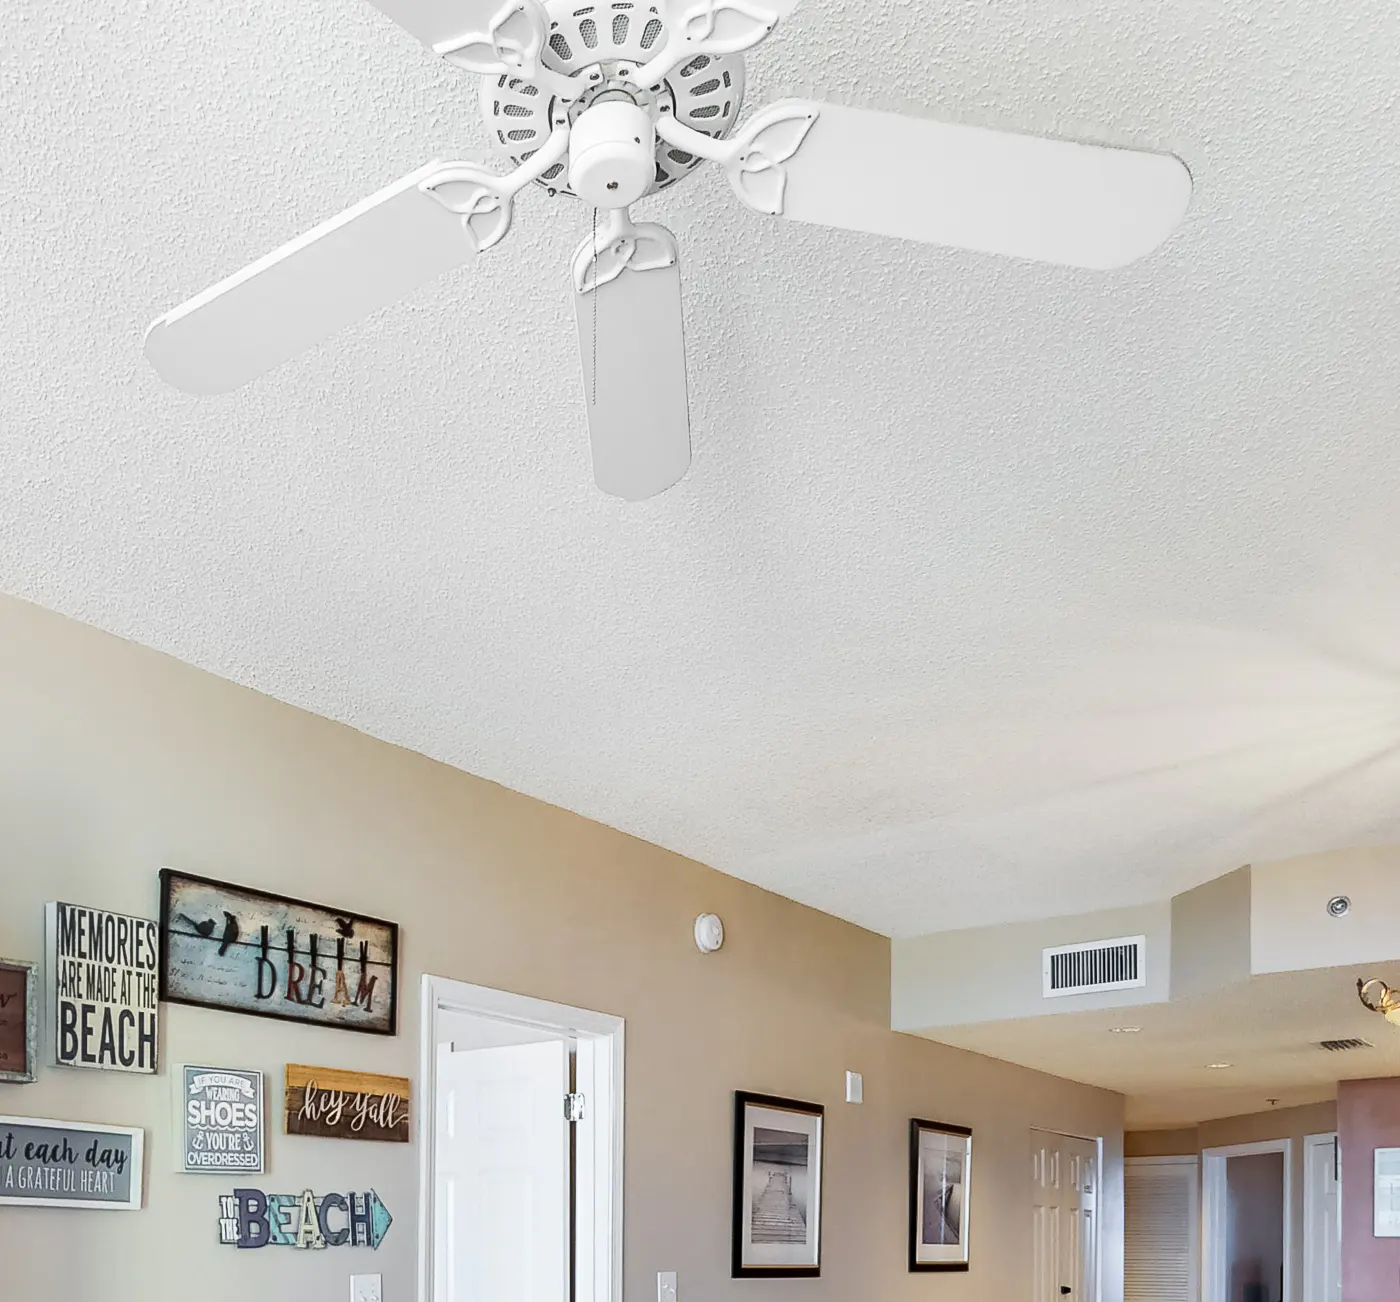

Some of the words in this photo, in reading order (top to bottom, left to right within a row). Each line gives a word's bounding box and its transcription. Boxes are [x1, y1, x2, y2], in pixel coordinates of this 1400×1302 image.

[60, 905, 156, 971] MEMORIES
[60, 959, 83, 999] ARE
[86, 963, 117, 1004] MADE
[120, 969, 133, 1006] AT
[136, 971, 156, 1009] THE
[254, 956, 378, 1013] DREAM
[60, 1000, 156, 1070] BEACH
[205, 1086, 240, 1102] WEARING
[208, 1075, 227, 1084] YOU
[228, 1077, 245, 1087] ARE
[187, 1099, 258, 1127] SHOES
[298, 1079, 350, 1126] hey
[205, 1132, 241, 1151] YOU'RE
[24, 1137, 79, 1165] each
[85, 1139, 127, 1175] day
[187, 1152, 258, 1166] OVERDRESSED
[5, 1165, 14, 1188] A
[18, 1166, 76, 1192] GRATEFUL
[80, 1169, 115, 1193] HEART
[220, 1197, 235, 1218] TO
[233, 1188, 373, 1250] BEACH
[219, 1218, 242, 1241] THE
